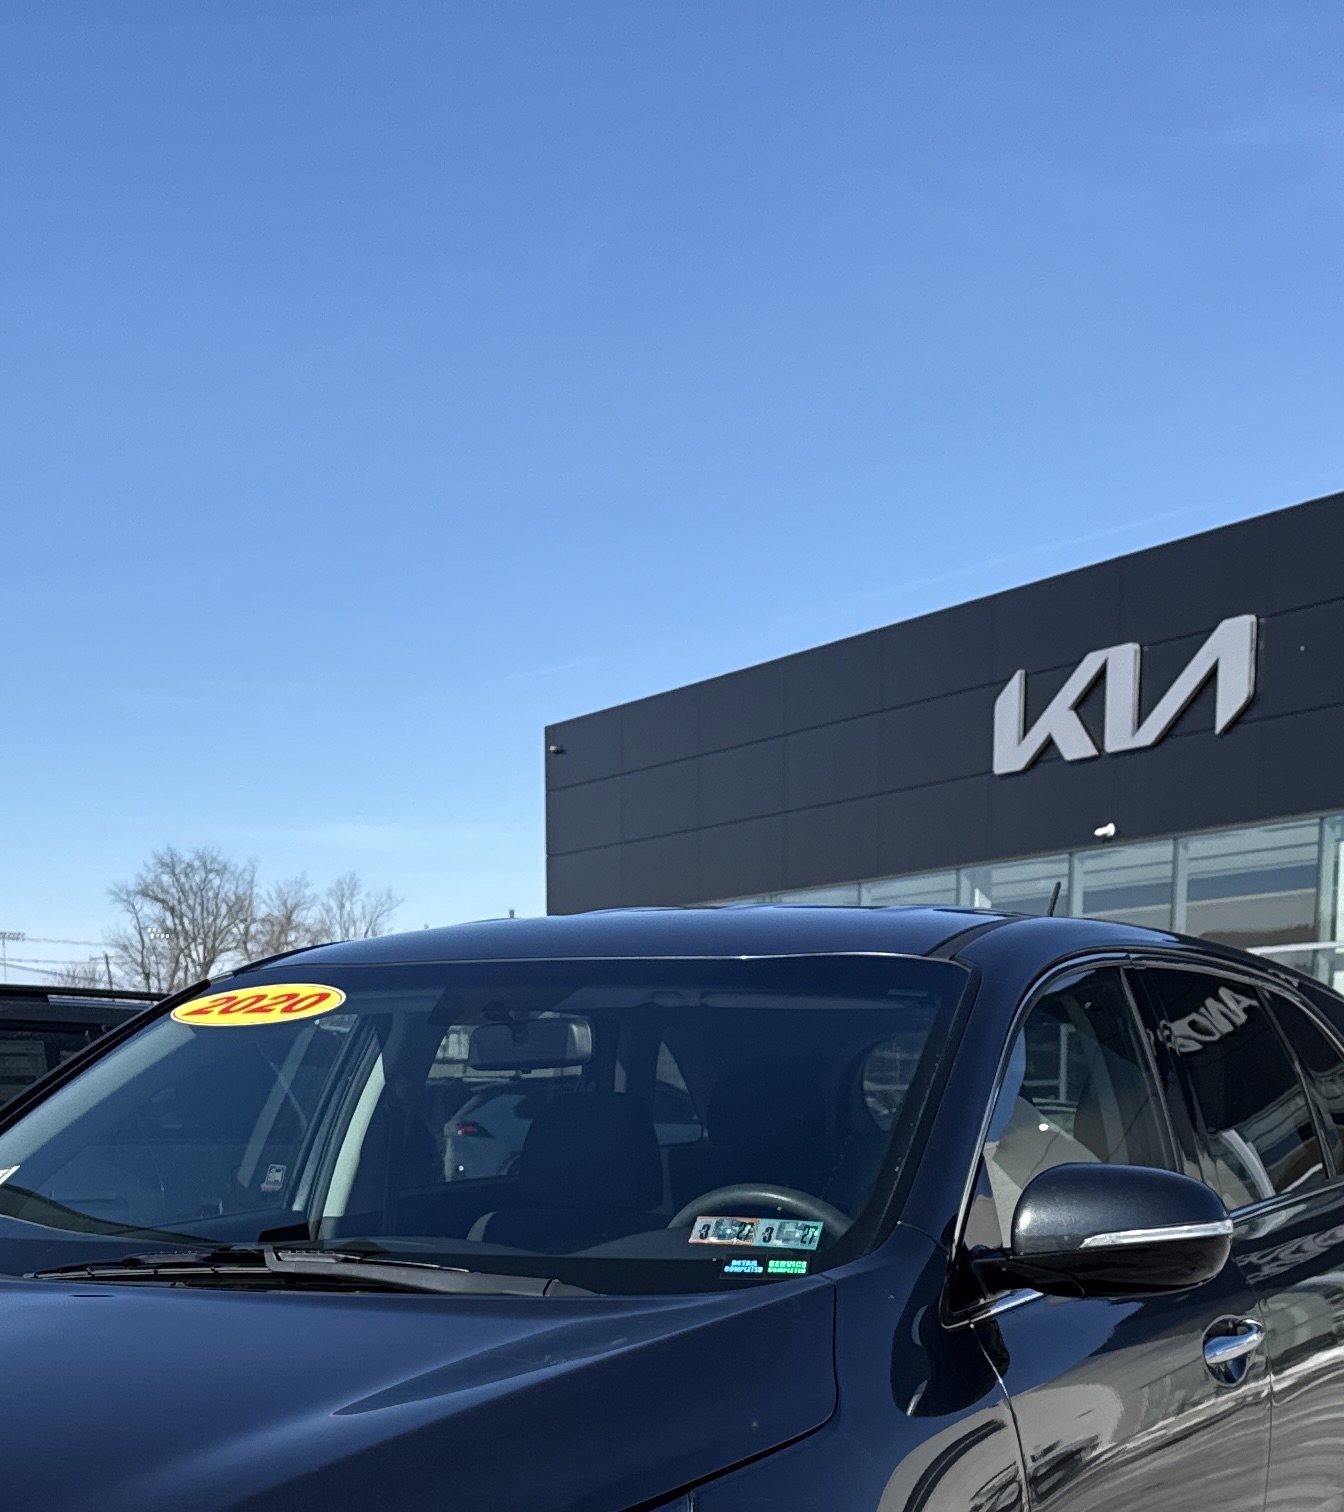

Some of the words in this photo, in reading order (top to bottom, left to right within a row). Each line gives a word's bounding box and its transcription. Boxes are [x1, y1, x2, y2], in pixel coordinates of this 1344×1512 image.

[993, 613, 1258, 776] KIA
[182, 992, 332, 1017] 2020
[699, 1224, 711, 1240] 3
[762, 1226, 774, 1243] 3
